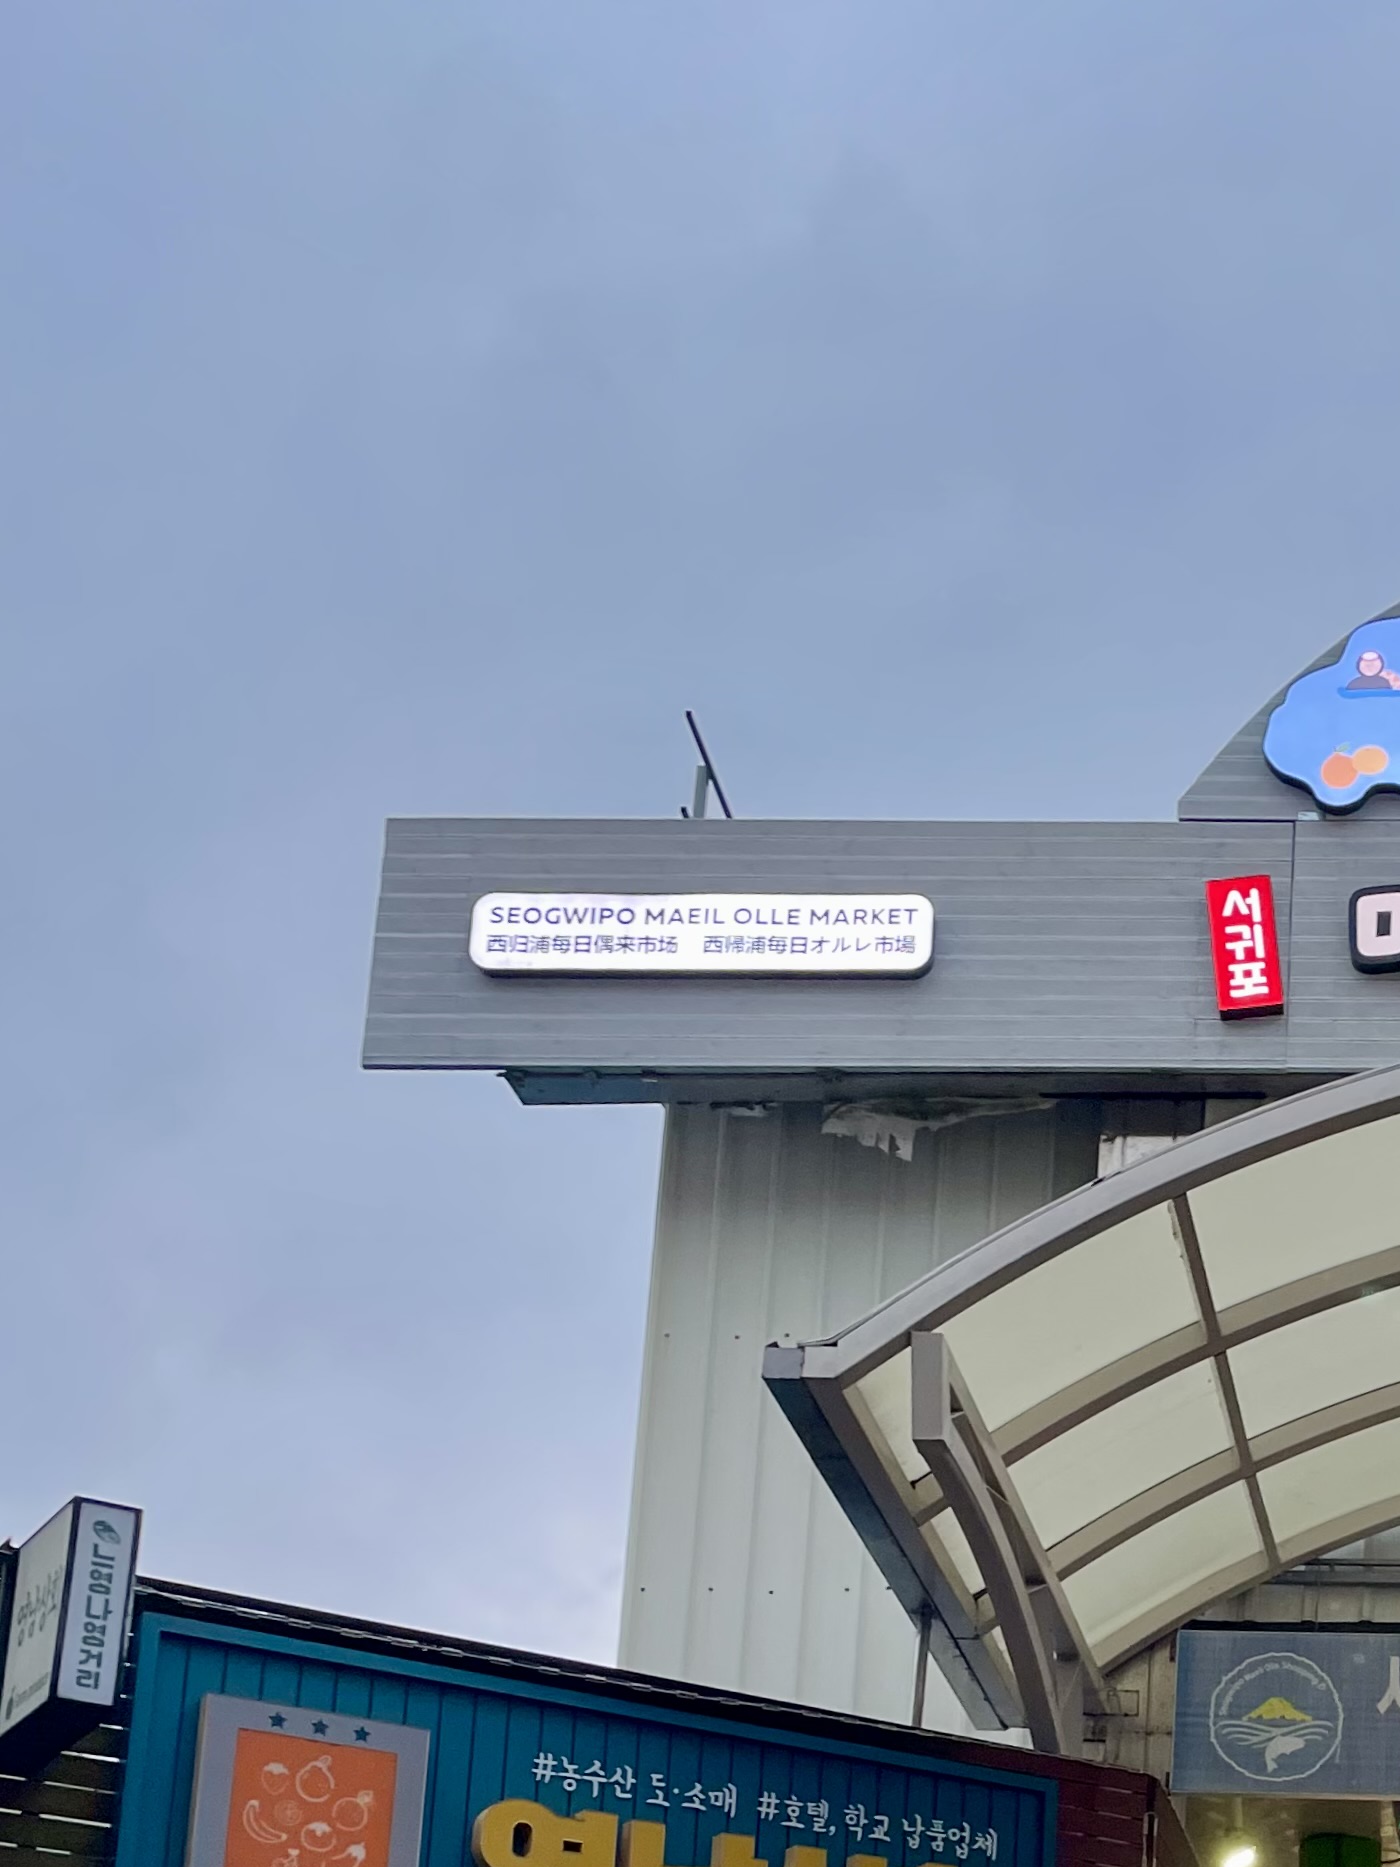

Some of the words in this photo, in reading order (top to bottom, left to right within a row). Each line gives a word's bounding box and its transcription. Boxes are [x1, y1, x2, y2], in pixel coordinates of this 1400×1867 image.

[490, 907, 635, 925] SEOGWIPO
[644, 907, 725, 925] MAEIL
[734, 908, 801, 925] OLLE
[809, 908, 919, 925] MARKET
[1220, 888, 1269, 1000] 서귀포
[531, 1752, 637, 1799] #농수산
[844, 1804, 892, 1842] 학교
[902, 1814, 998, 1861] 납품업체
